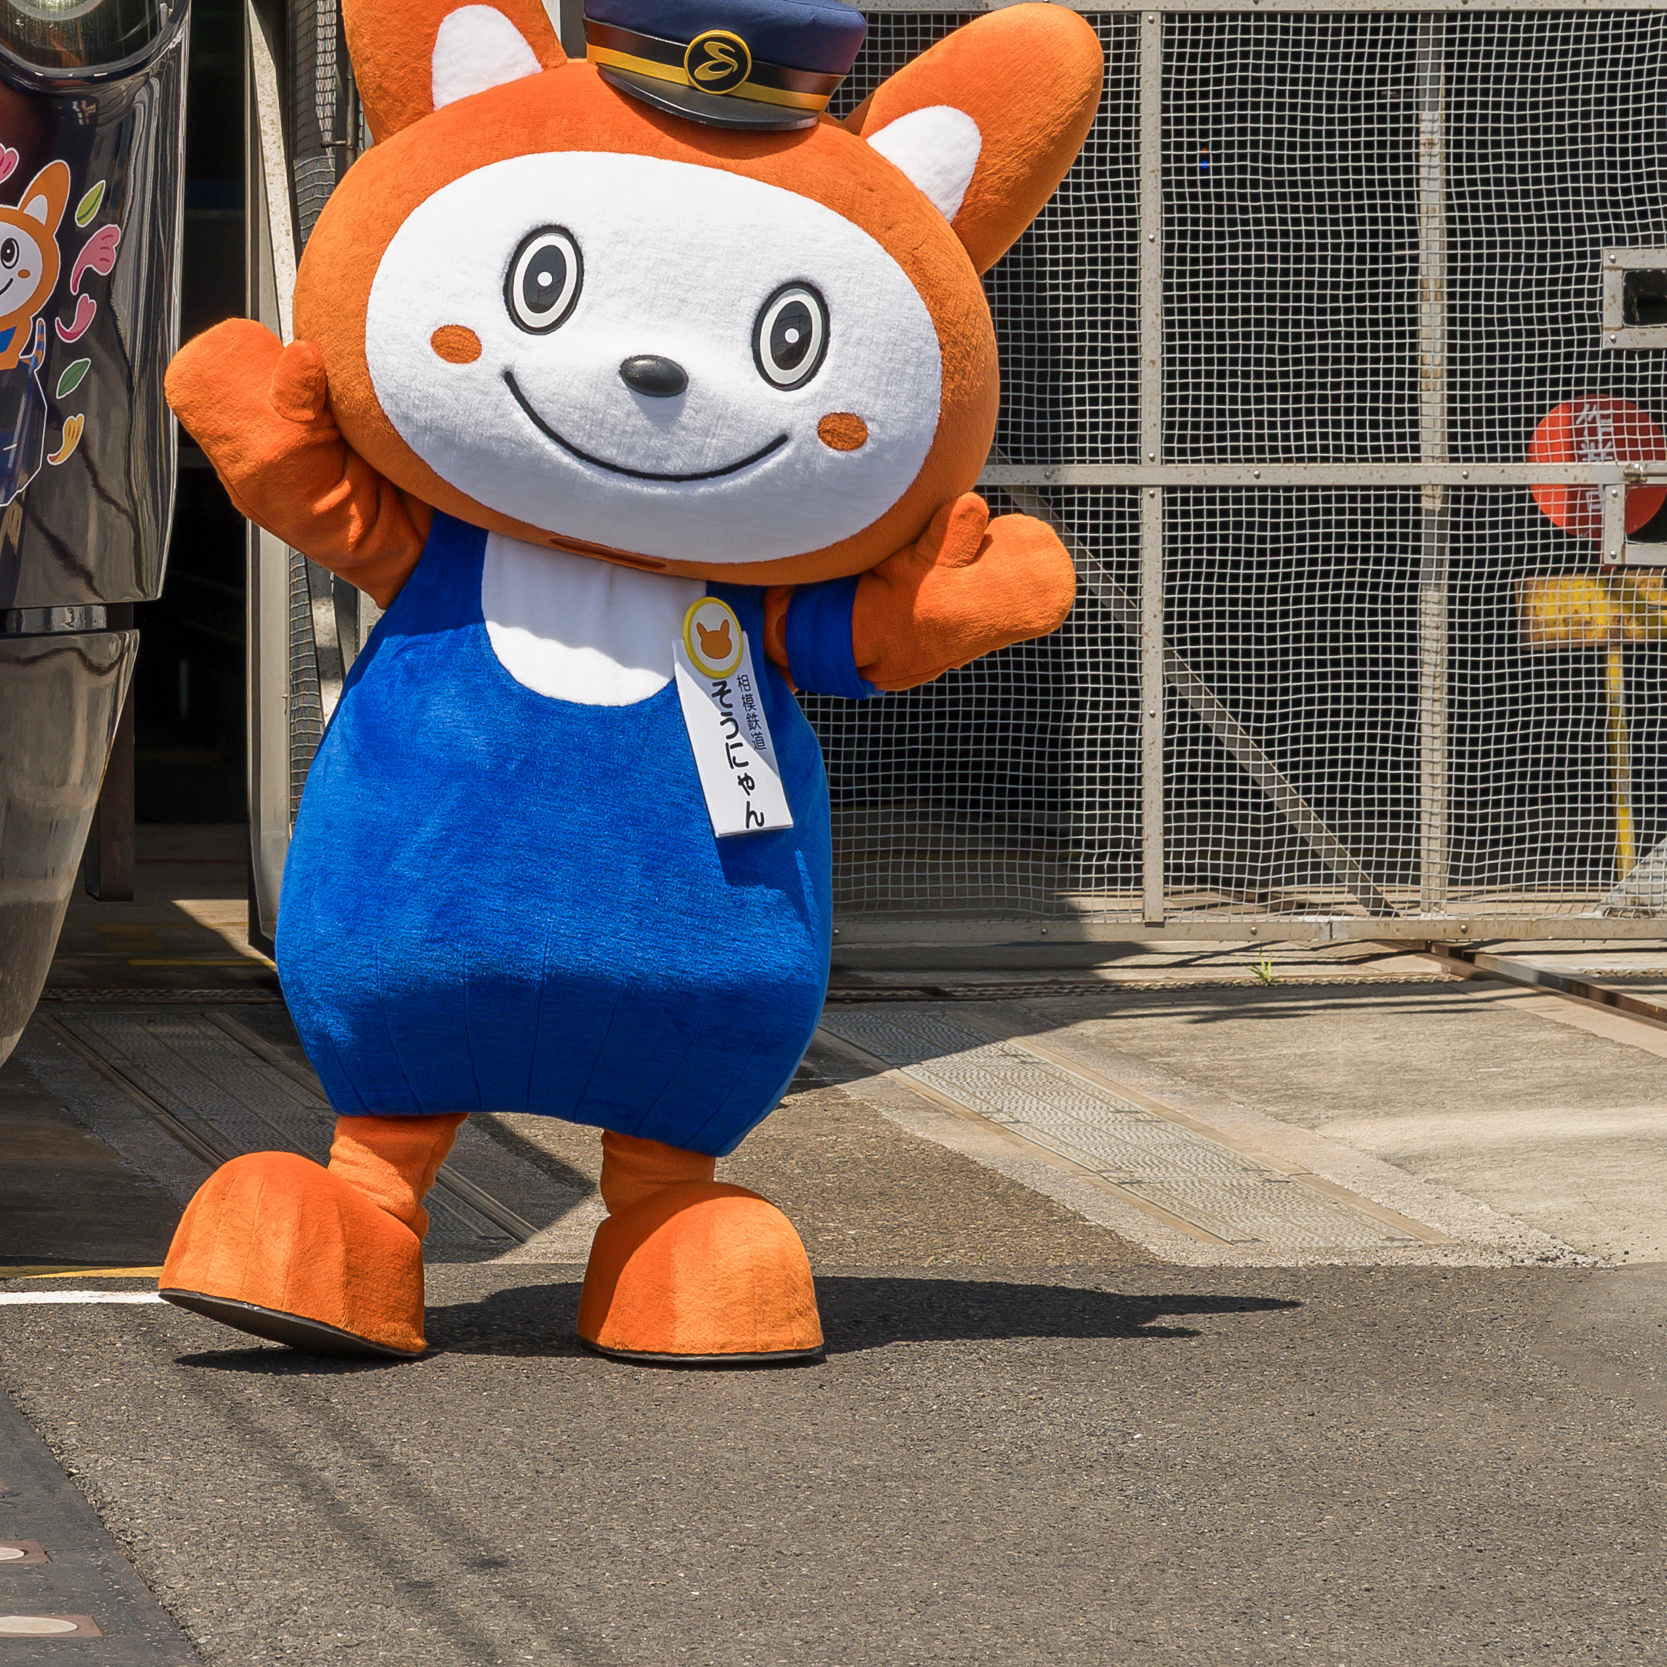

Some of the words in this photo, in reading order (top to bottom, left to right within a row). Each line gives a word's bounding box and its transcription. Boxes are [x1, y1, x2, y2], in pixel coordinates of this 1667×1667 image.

[711, 680, 765, 829] そうにゃん
[735, 674, 767, 751] 相模鉄道
